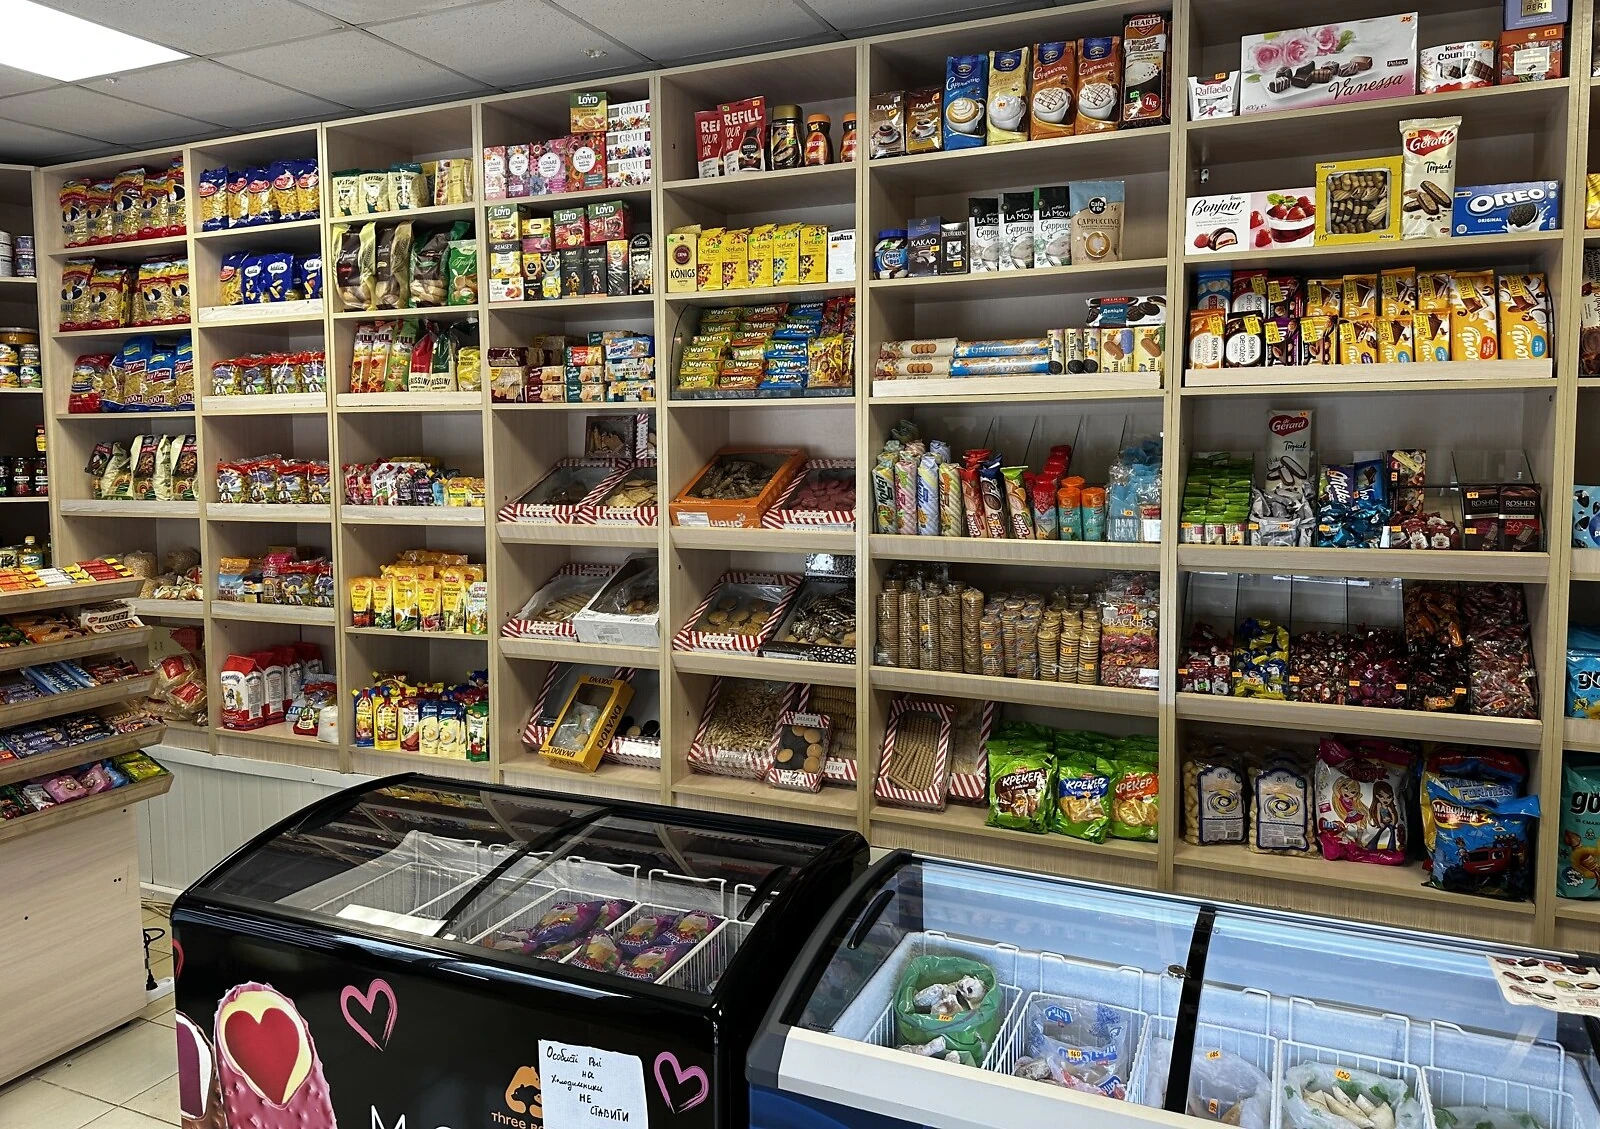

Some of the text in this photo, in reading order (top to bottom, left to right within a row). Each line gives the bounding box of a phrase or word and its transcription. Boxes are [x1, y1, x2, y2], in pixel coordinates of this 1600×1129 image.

[1130, 18, 1160, 26] HEARTS
[1445, 44, 1465, 52] Kinder
[1438, 49, 1477, 61] Country
[1032, 65, 1068, 80] Cappuccino
[1078, 61, 1115, 76] Cappuccino
[946, 76, 980, 91] Cappuccino
[1328, 72, 1406, 100] Vanessa
[1195, 85, 1232, 96] Raffaello
[577, 96, 598, 105] LOYD
[723, 108, 763, 126] REFILL
[1423, 160, 1453, 174] Tropical
[1469, 187, 1546, 213] OREO
[493, 208, 511, 217] LOYD
[595, 205, 614, 215] LOYD
[1192, 199, 1245, 217] Bonjour
[559, 212, 577, 222] LOYD
[1006, 213, 1015, 221] LA
[1041, 210, 1051, 218] LA
[986, 216, 999, 224] MO
[1077, 218, 1120, 226] CAPPUCCINO
[976, 226, 999, 238] Cappu
[777, 241, 796, 249] Stefano
[910, 238, 937, 247] KAKAO
[754, 305, 776, 314] Wafers
[786, 322, 809, 331] Wafers
[700, 335, 723, 343] Wafers
[744, 331, 767, 339] Wafers
[775, 343, 799, 351] Wafers
[1211, 337, 1219, 361] ROSHEN
[689, 360, 712, 368] Wafers
[735, 360, 760, 368] Wafers
[777, 360, 801, 368] Wafers
[686, 374, 708, 382] Wafers
[1271, 419, 1306, 432] Gerard
[1283, 440, 1307, 451] Tropical
[876, 474, 887, 505] LEMON
[1471, 499, 1499, 507] ROSHEN
[1100, 617, 1154, 629] CRACKERS
[1002, 771, 1042, 787] КРЕКЕР
[1065, 777, 1105, 791] КРЕКЕР
[1433, 804, 1479, 818] МАШИНКА
[582, 1070, 595, 1080] на
[579, 1093, 592, 1104] НЕ
[590, 1105, 629, 1123] СТАВИТИ
[491, 1110, 526, 1129] Three
